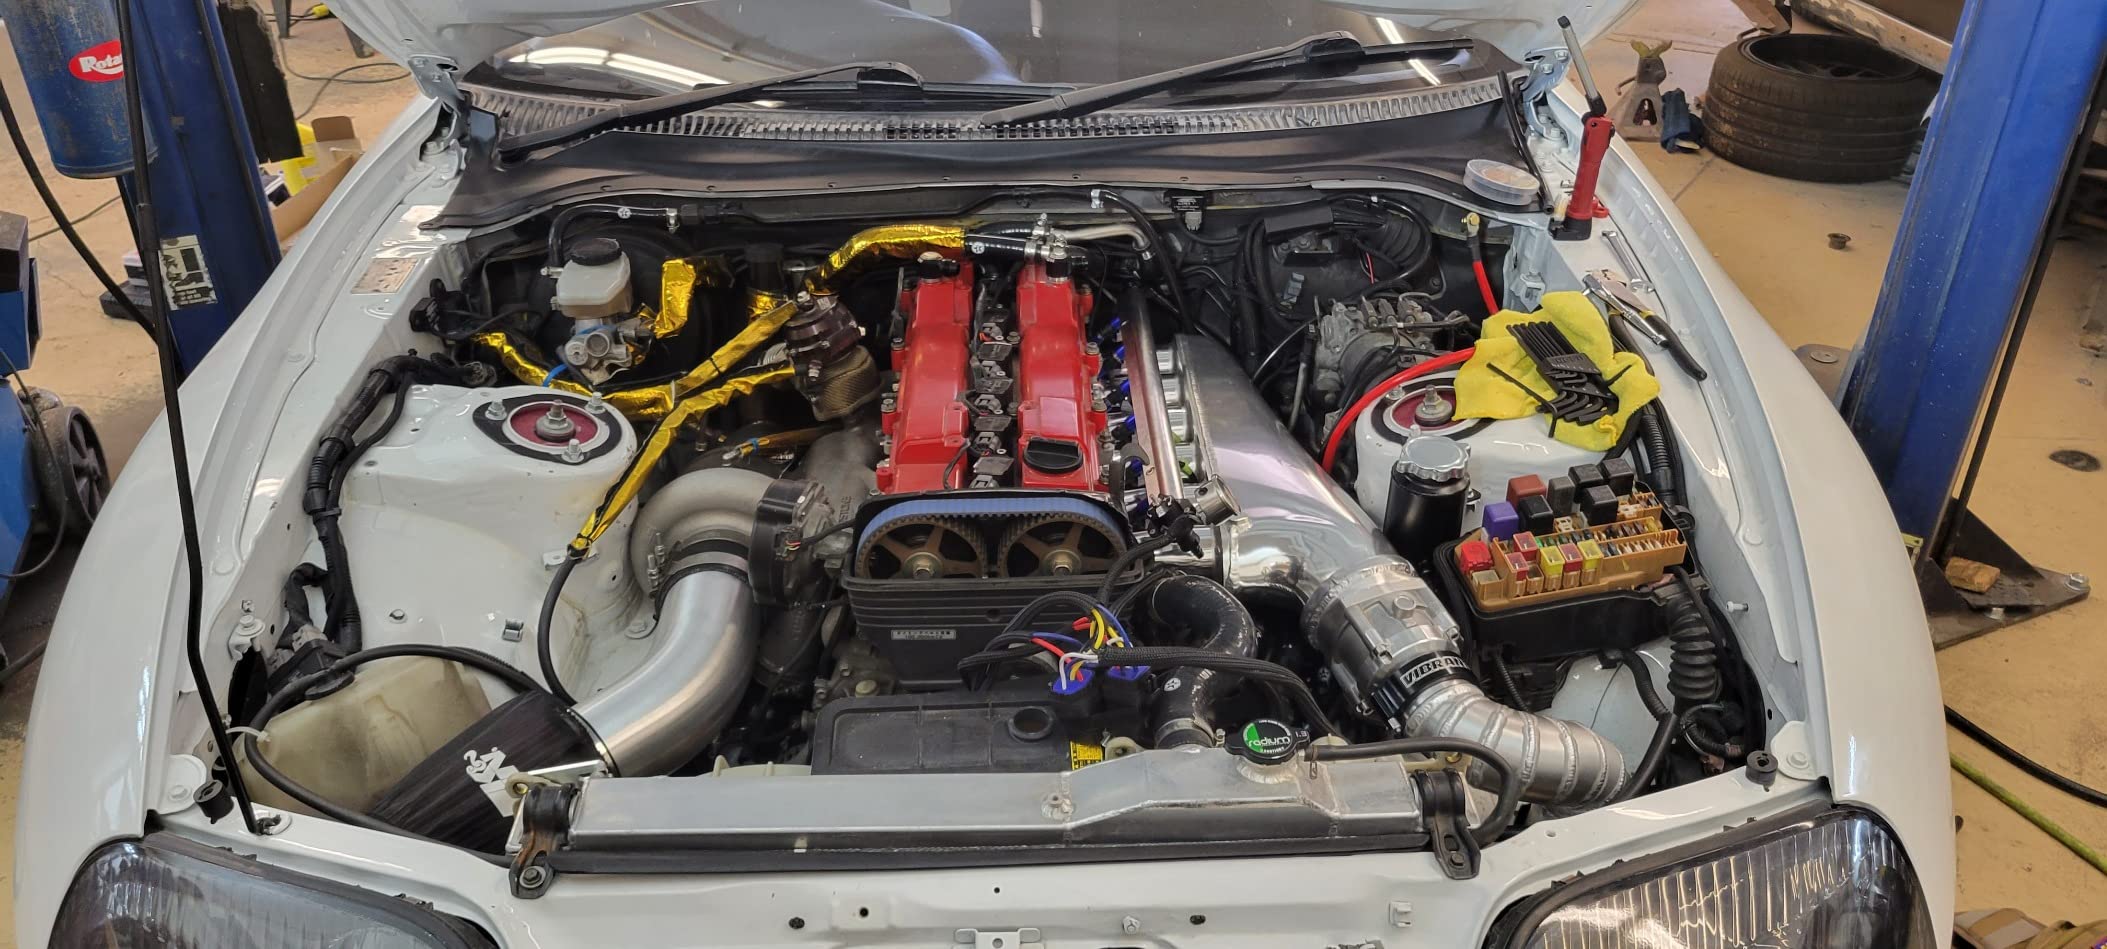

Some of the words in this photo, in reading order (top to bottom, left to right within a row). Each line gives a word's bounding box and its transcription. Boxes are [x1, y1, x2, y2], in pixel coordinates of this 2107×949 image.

[79, 54, 122, 74] Rota
[1401, 656, 1470, 687] VIBRAN
[1248, 736, 1290, 747] radium
